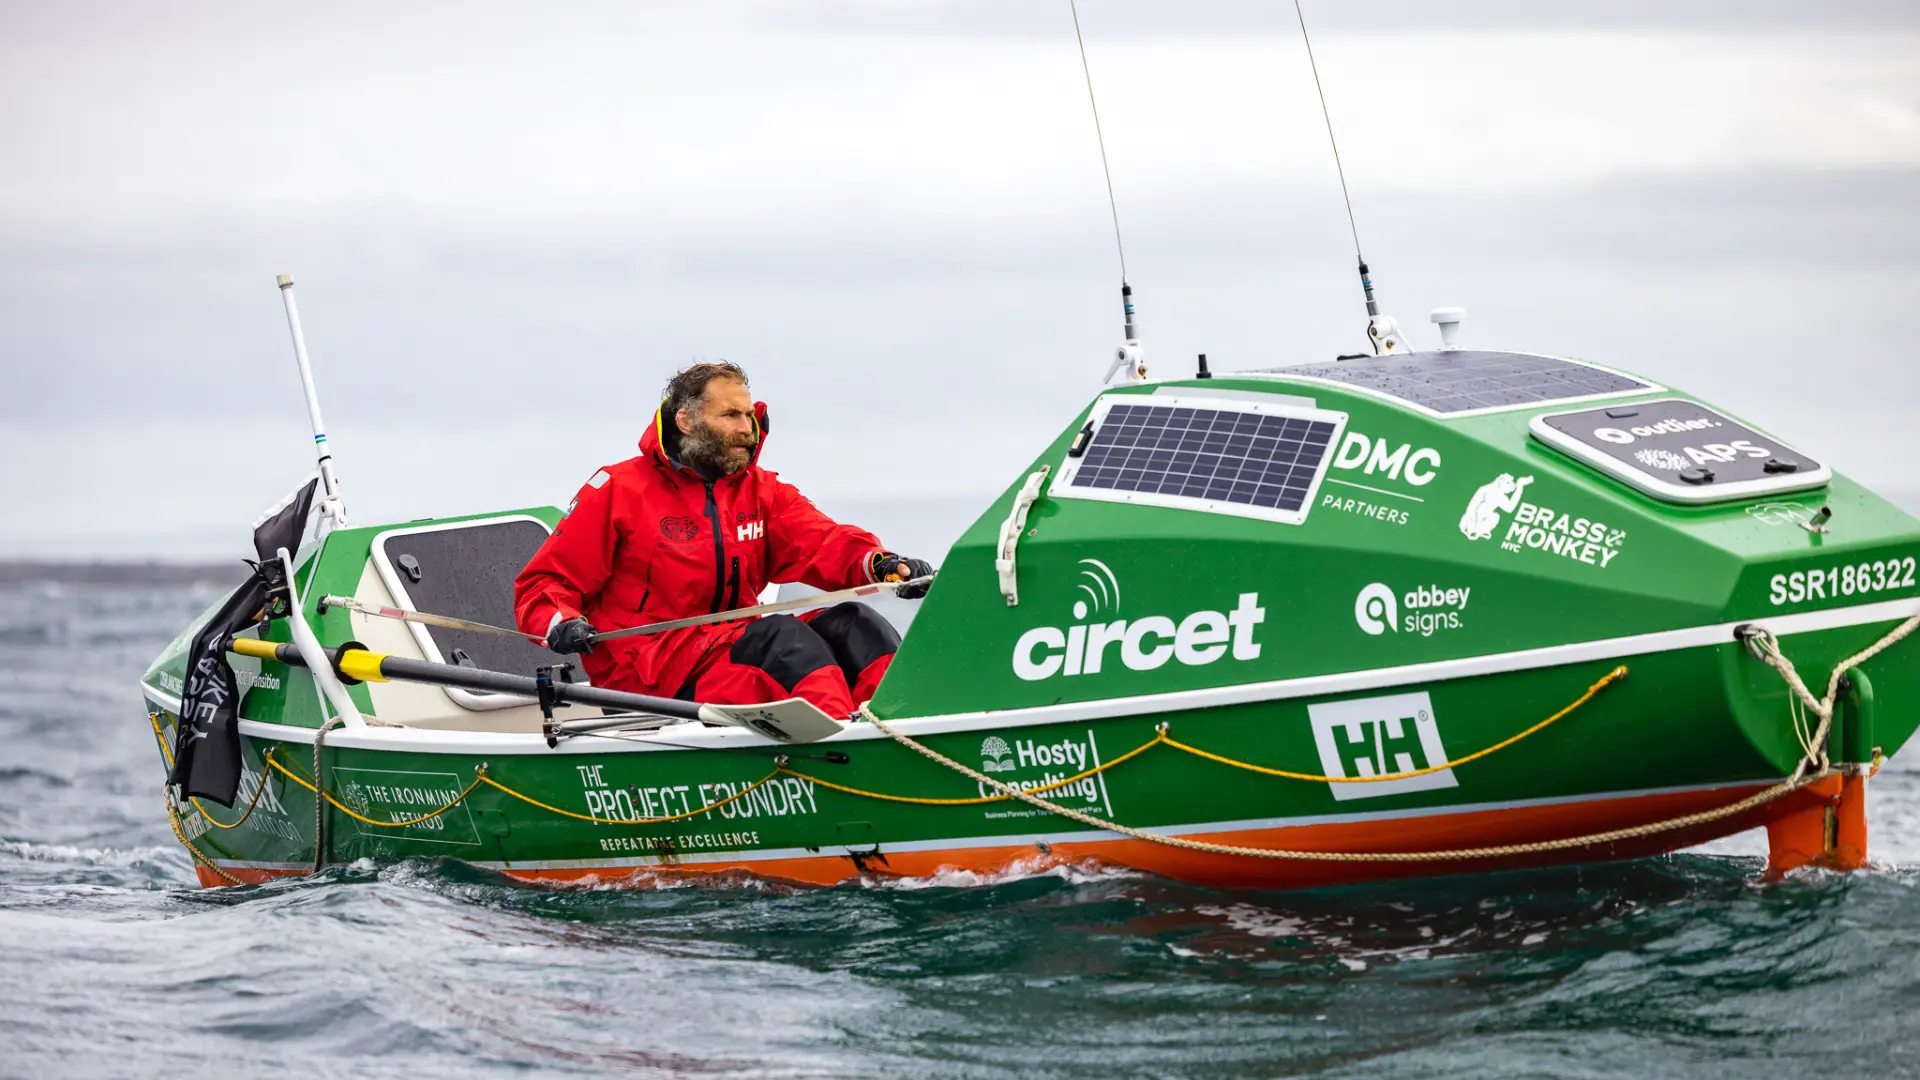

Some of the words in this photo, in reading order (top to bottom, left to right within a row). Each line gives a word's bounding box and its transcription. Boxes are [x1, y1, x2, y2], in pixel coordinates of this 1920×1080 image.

[1333, 431, 1441, 486] DMC
[1684, 440, 1771, 465] APS
[1322, 495, 1410, 525] PARTNERS
[1514, 502, 1608, 543] BRASS
[737, 520, 764, 542] HH
[1505, 521, 1619, 568] MONKEY
[1500, 541, 1522, 553] NYC
[1769, 557, 1916, 605] SSR186322
[1403, 584, 1471, 610] abbey
[1012, 592, 1266, 681] circet
[1404, 610, 1464, 637] signs.
[247, 671, 280, 690] Transition
[1015, 739, 1086, 771] Hosty
[1331, 717, 1431, 778] HH
[576, 765, 608, 787] THE
[366, 785, 391, 803] THE
[391, 787, 461, 807] IRONMIND
[585, 785, 692, 825] PROJECT
[699, 777, 817, 820] FOUNDRY
[389, 811, 444, 830] METHOD
[678, 831, 760, 849] EXCELLENCE
